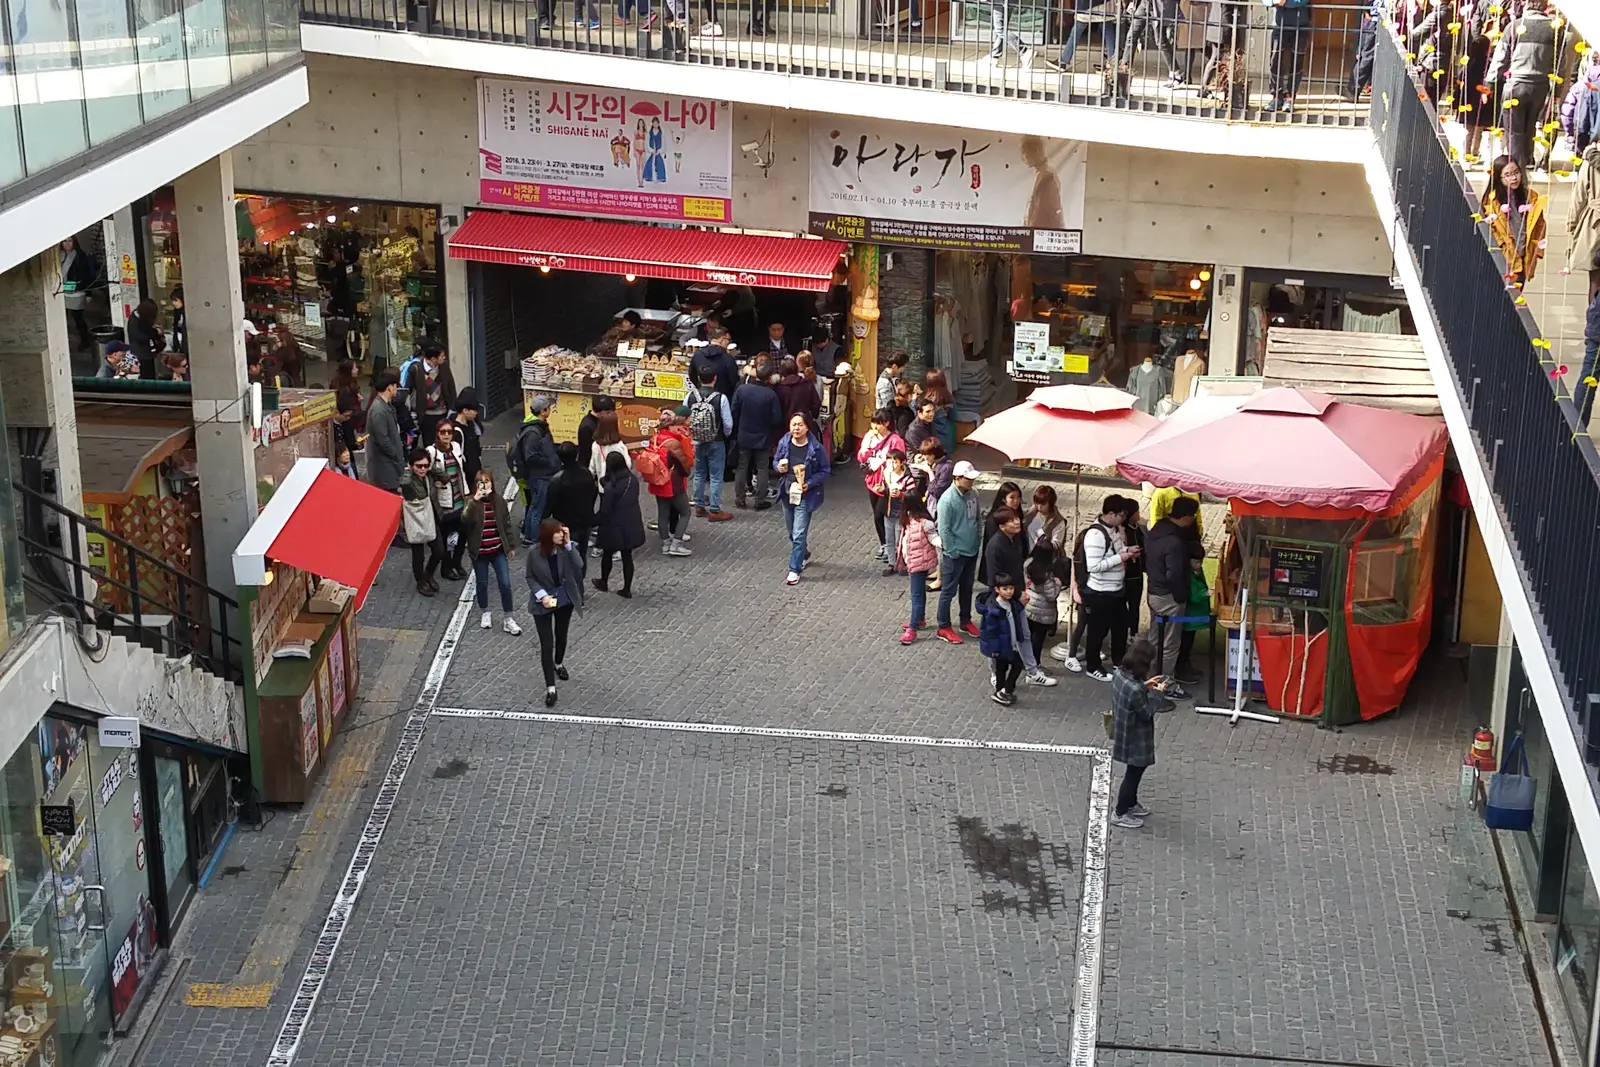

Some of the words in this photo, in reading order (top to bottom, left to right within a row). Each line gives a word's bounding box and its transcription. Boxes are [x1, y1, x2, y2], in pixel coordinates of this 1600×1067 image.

[546, 91, 626, 125] 시간의
[663, 100, 716, 130] 나이
[505, 156, 520, 165] 2016.
[521, 158, 527, 166] 3.
[832, 135, 990, 189] 아랑가
[513, 183, 541, 194] 티켓증정
[571, 189, 586, 198] 5만원
[587, 191, 598, 199] 이상
[830, 192, 868, 203] 2016.02.14
[876, 198, 897, 206] 04.10
[900, 198, 937, 209] 충무아트홀
[939, 201, 961, 210] 중극장
[963, 201, 978, 211] 블랙
[837, 216, 866, 227] 티켓증정
[837, 226, 865, 239] 이벤트
[104, 729, 132, 737] MOMOT
[45, 816, 72, 826] SHOW
